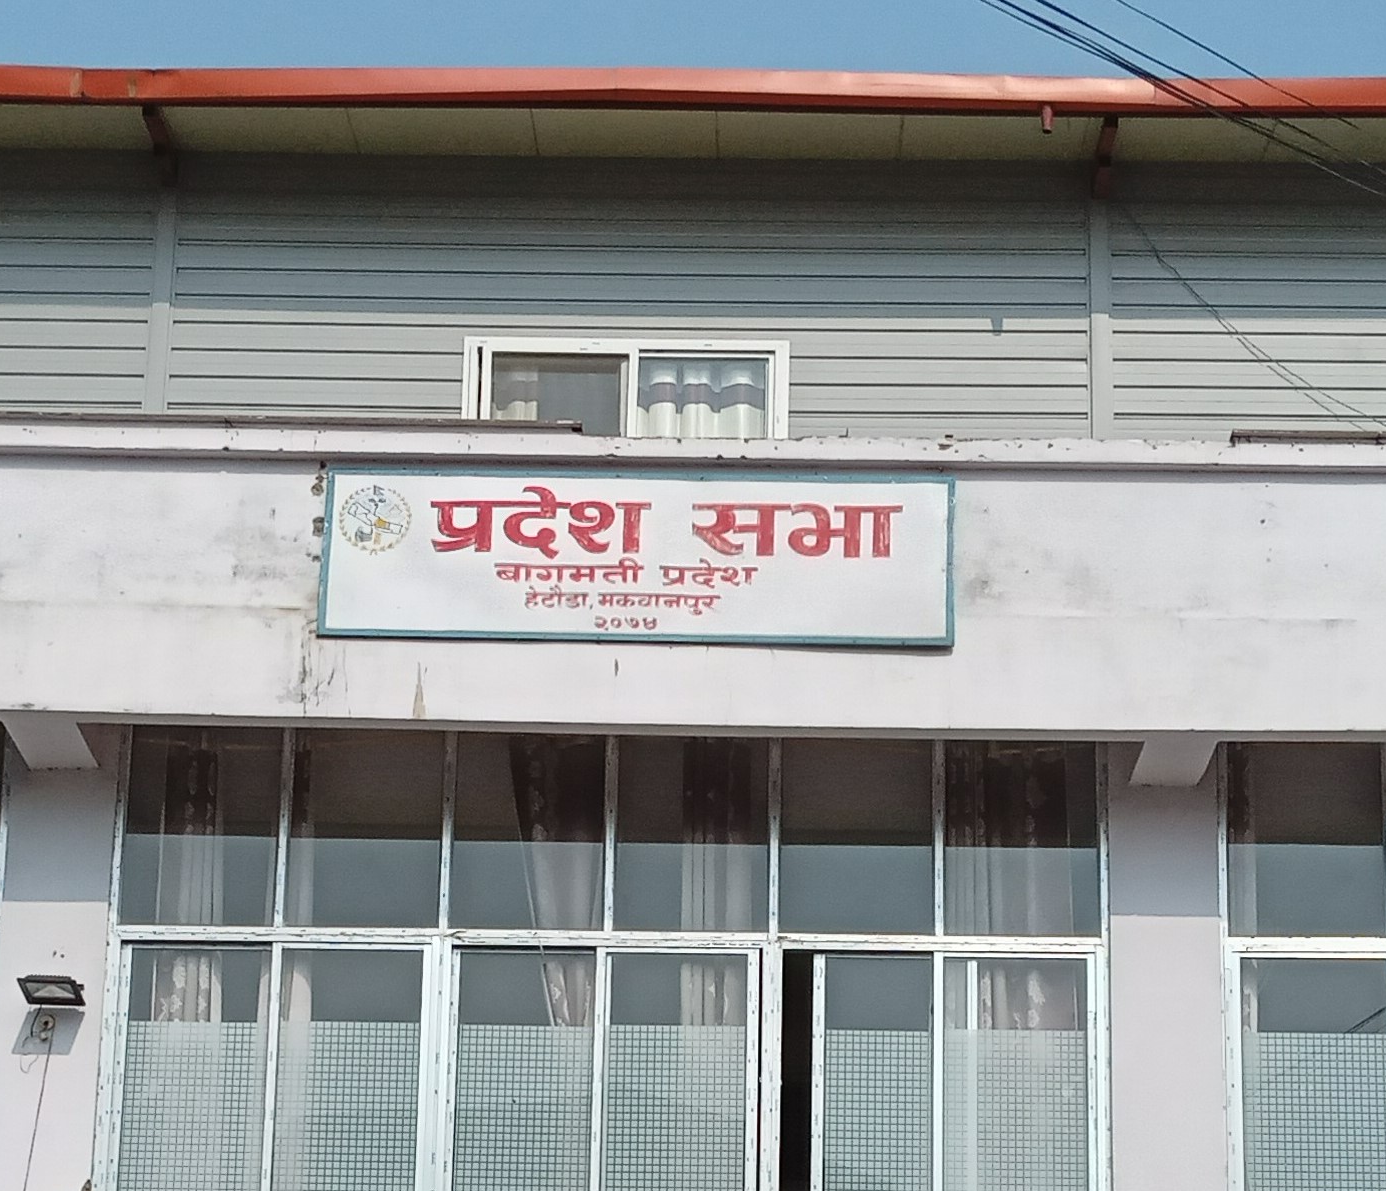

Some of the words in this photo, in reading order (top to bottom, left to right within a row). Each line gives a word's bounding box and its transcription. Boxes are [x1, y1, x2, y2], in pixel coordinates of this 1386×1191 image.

[430, 485, 651, 558] प्रदेश
[693, 502, 902, 558] सभा
[496, 560, 644, 586] बागमती
[660, 560, 757, 588] प्रदेश
